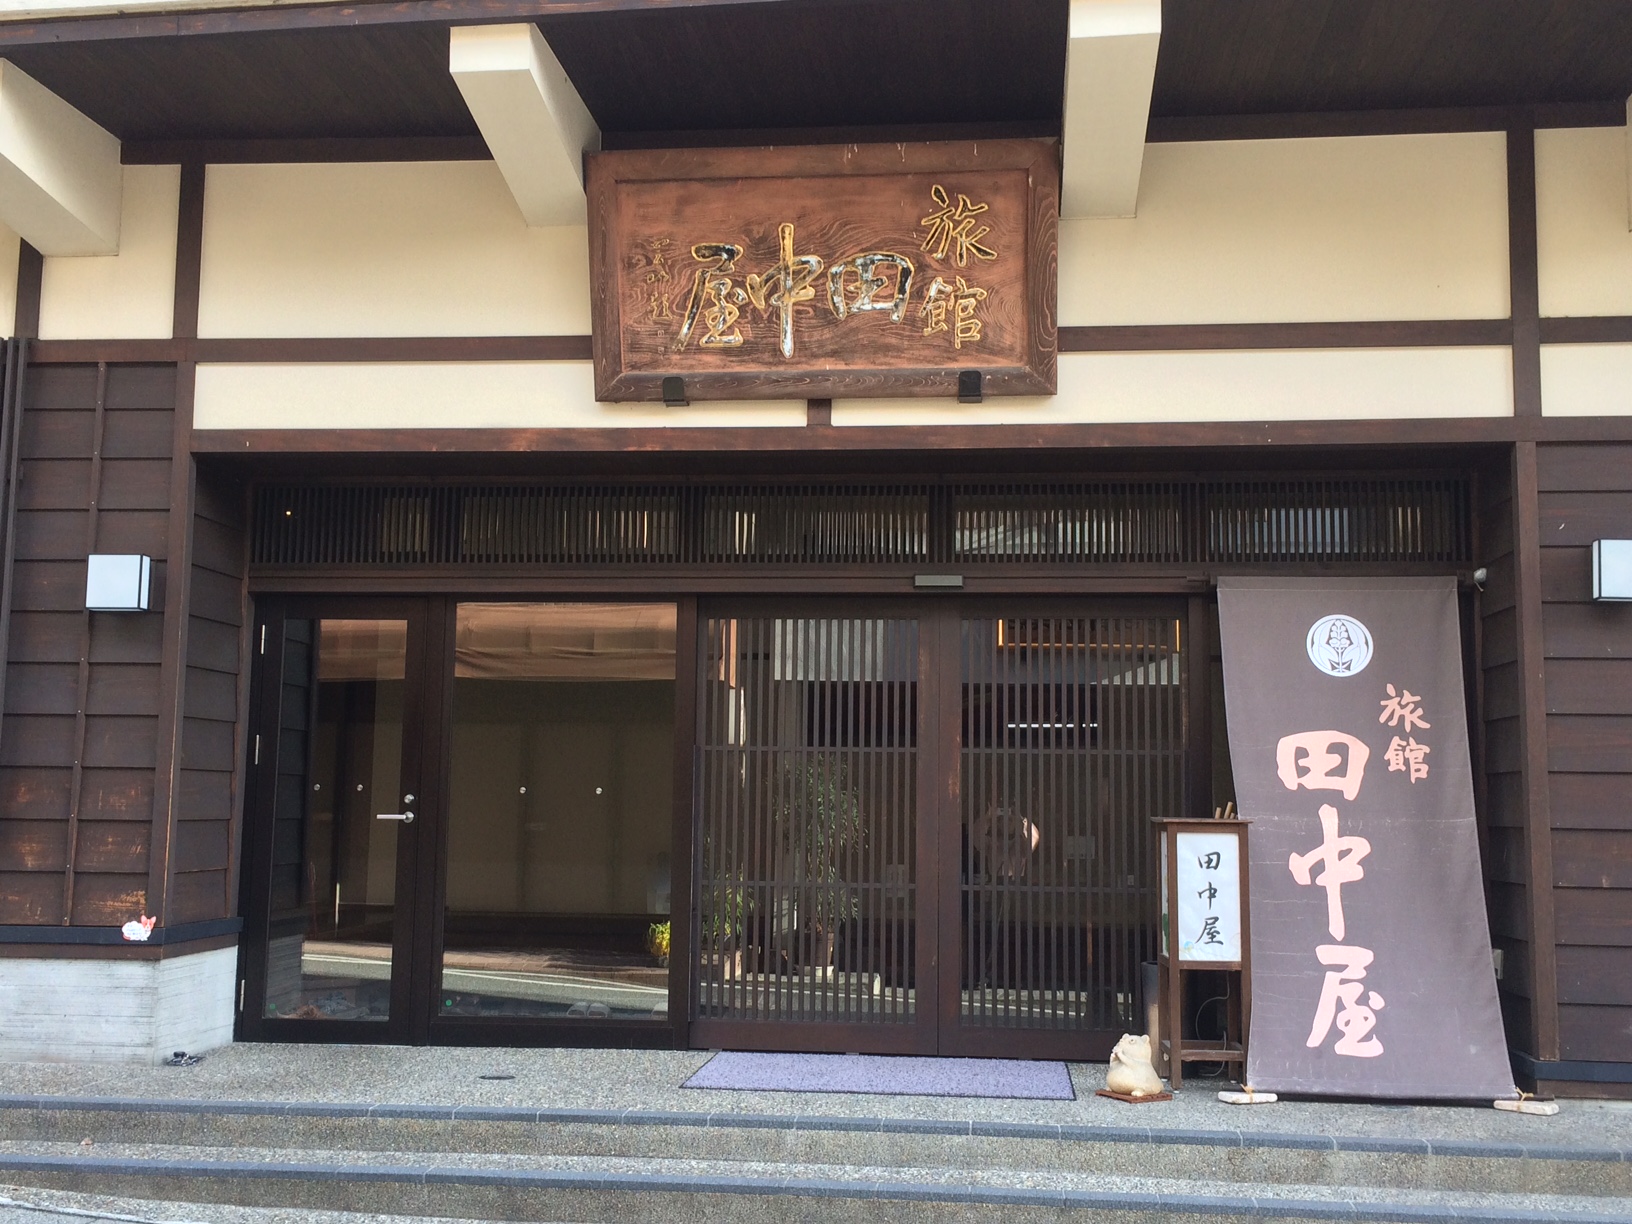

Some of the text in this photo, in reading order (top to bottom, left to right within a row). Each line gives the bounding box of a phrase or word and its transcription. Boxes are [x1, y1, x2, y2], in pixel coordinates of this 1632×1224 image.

[673, 223, 915, 358] 田中屋
[921, 184, 997, 350] 旅館
[1379, 683, 1431, 783] 旅館
[1196, 851, 1224, 945] 田中屋
[1276, 730, 1385, 1058] 田中屋
